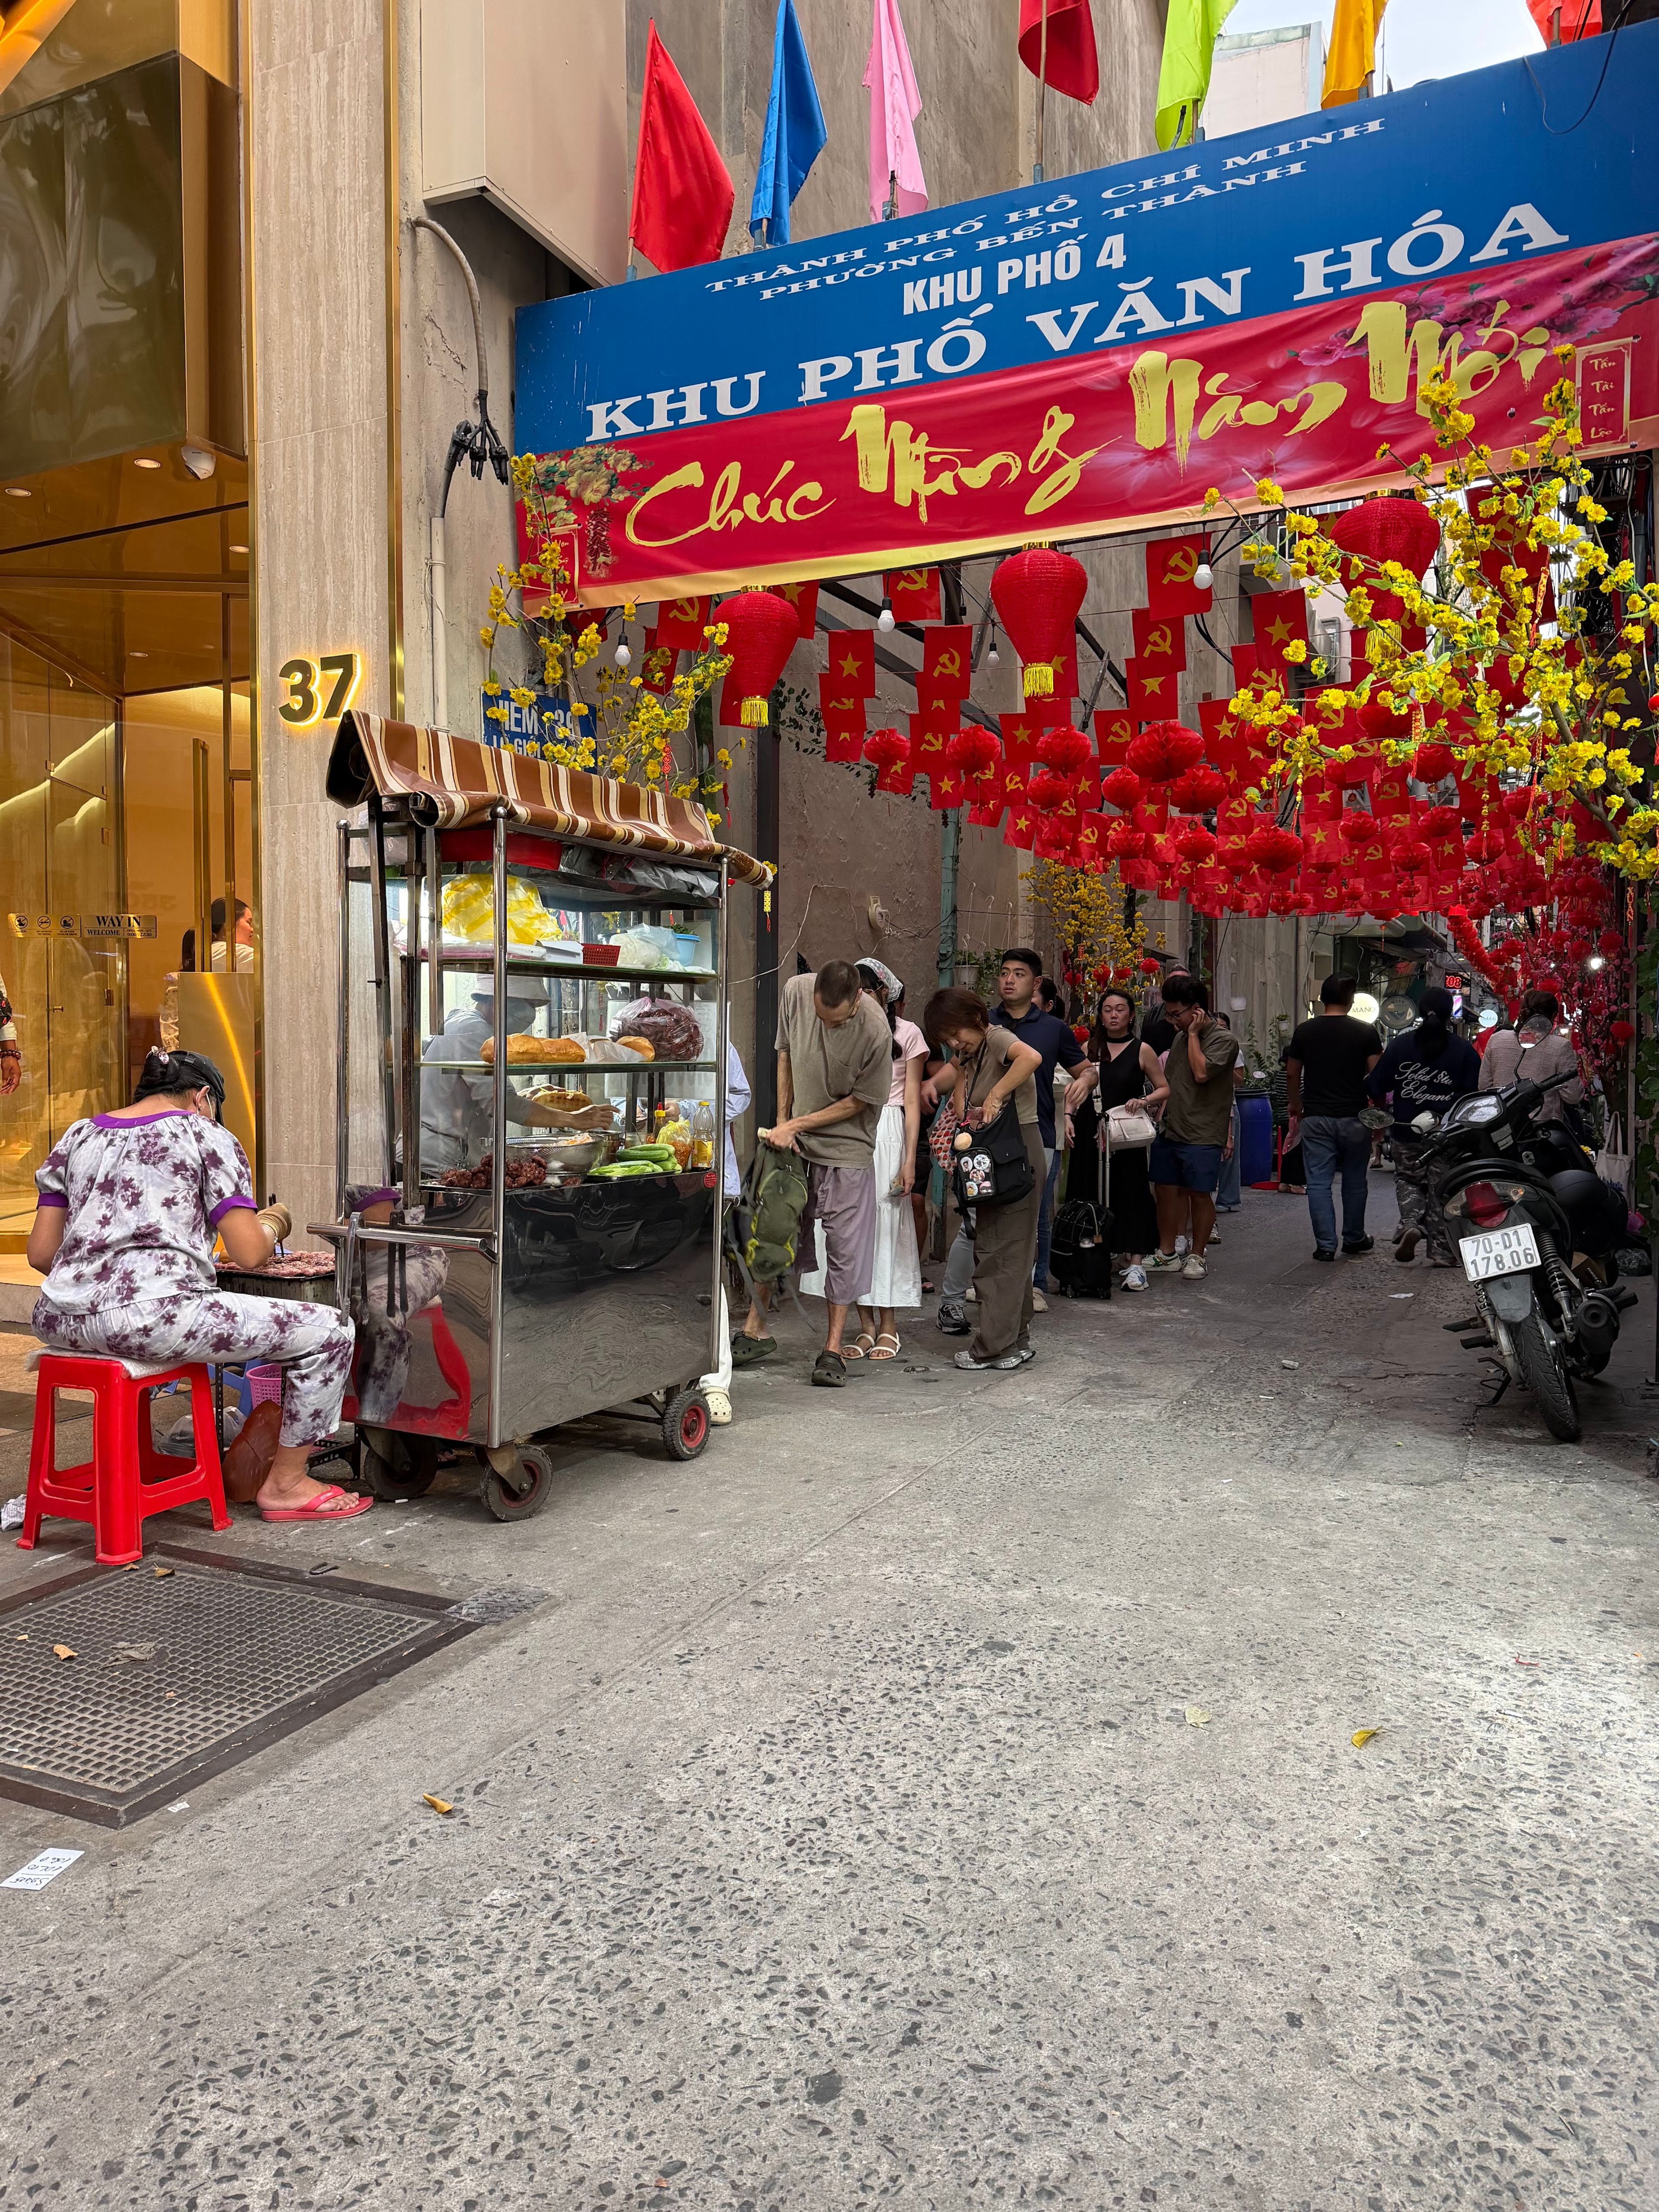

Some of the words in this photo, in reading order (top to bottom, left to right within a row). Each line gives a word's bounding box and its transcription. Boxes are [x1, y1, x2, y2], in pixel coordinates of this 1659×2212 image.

[705, 247, 867, 292] THÀNH
[884, 214, 987, 253] PHỐ
[1005, 194, 1077, 224] HỒ
[1101, 164, 1201, 199] CHÍ
[1222, 118, 1385, 171] MINH
[760, 248, 957, 300] PHƯỜNG
[976, 216, 1082, 251] BẾN
[1101, 161, 1306, 220] THÀNH
[903, 266, 982, 315] KHU
[998, 233, 1088, 295] PHỐ
[1096, 233, 1126, 270] 4
[585, 371, 766, 443] KHU
[798, 302, 994, 402] PHỐ
[1025, 267, 1251, 352] VĂN
[1294, 203, 1570, 301] HÓA
[1589, 357, 1617, 371] Tấn
[1591, 381, 1615, 393] Tài
[625, 460, 837, 548] Chúc
[838, 404, 1123, 526] Mừng
[1128, 350, 1348, 483] Năm
[1344, 299, 1550, 419] Mới
[1588, 403, 1616, 416] Tấn
[1590, 427, 1612, 439] Lộc
[278, 654, 356, 723] 37
[96, 915, 124, 927] WAY
[127, 916, 141, 927] IN
[1395, 1062, 1438, 1081] Solid
[1471, 1230, 1522, 1256] 70-D1
[1470, 1247, 1535, 1277] 178.06
